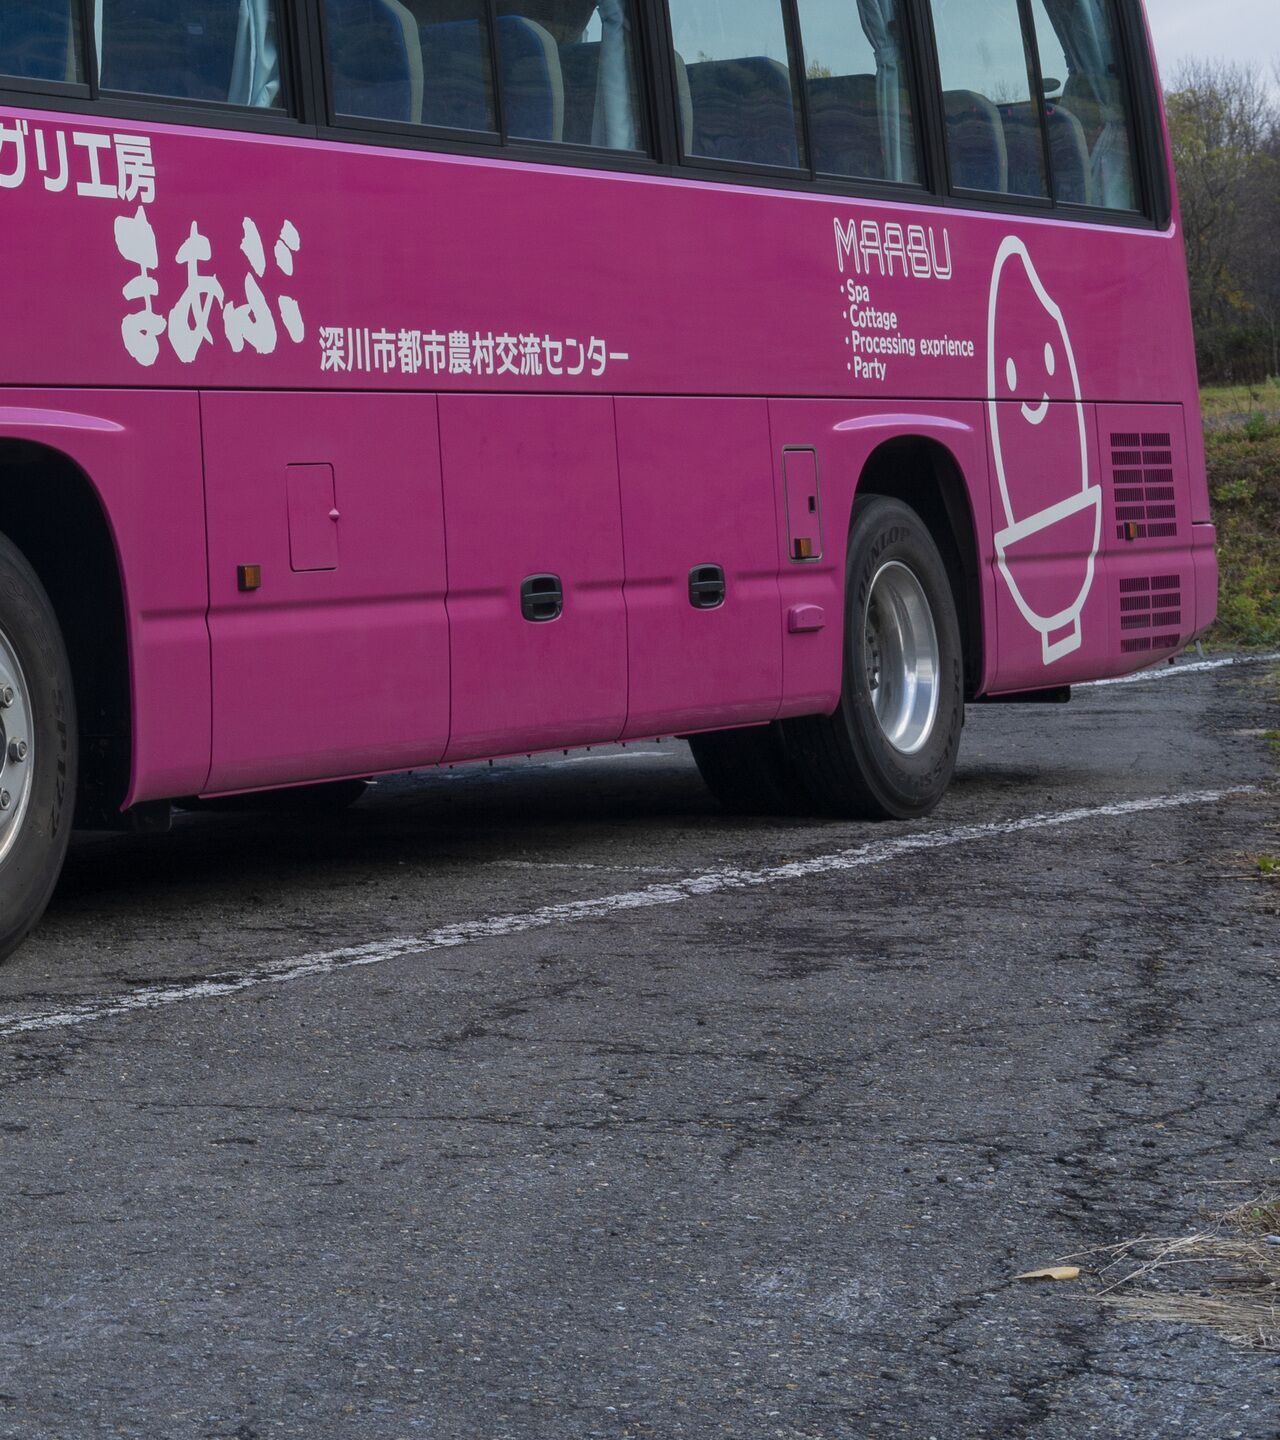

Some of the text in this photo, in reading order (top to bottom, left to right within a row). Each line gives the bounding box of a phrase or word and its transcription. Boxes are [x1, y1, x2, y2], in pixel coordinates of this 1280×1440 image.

[833, 217, 952, 280] MAABU
[114, 205, 305, 366] まあぶ
[846, 278, 870, 303] Spa
[849, 304, 897, 330] Cottage
[319, 326, 629, 377] 深川市都市農村交流センター
[851, 330, 975, 358] Processing exprience
[854, 356, 886, 381] Party
